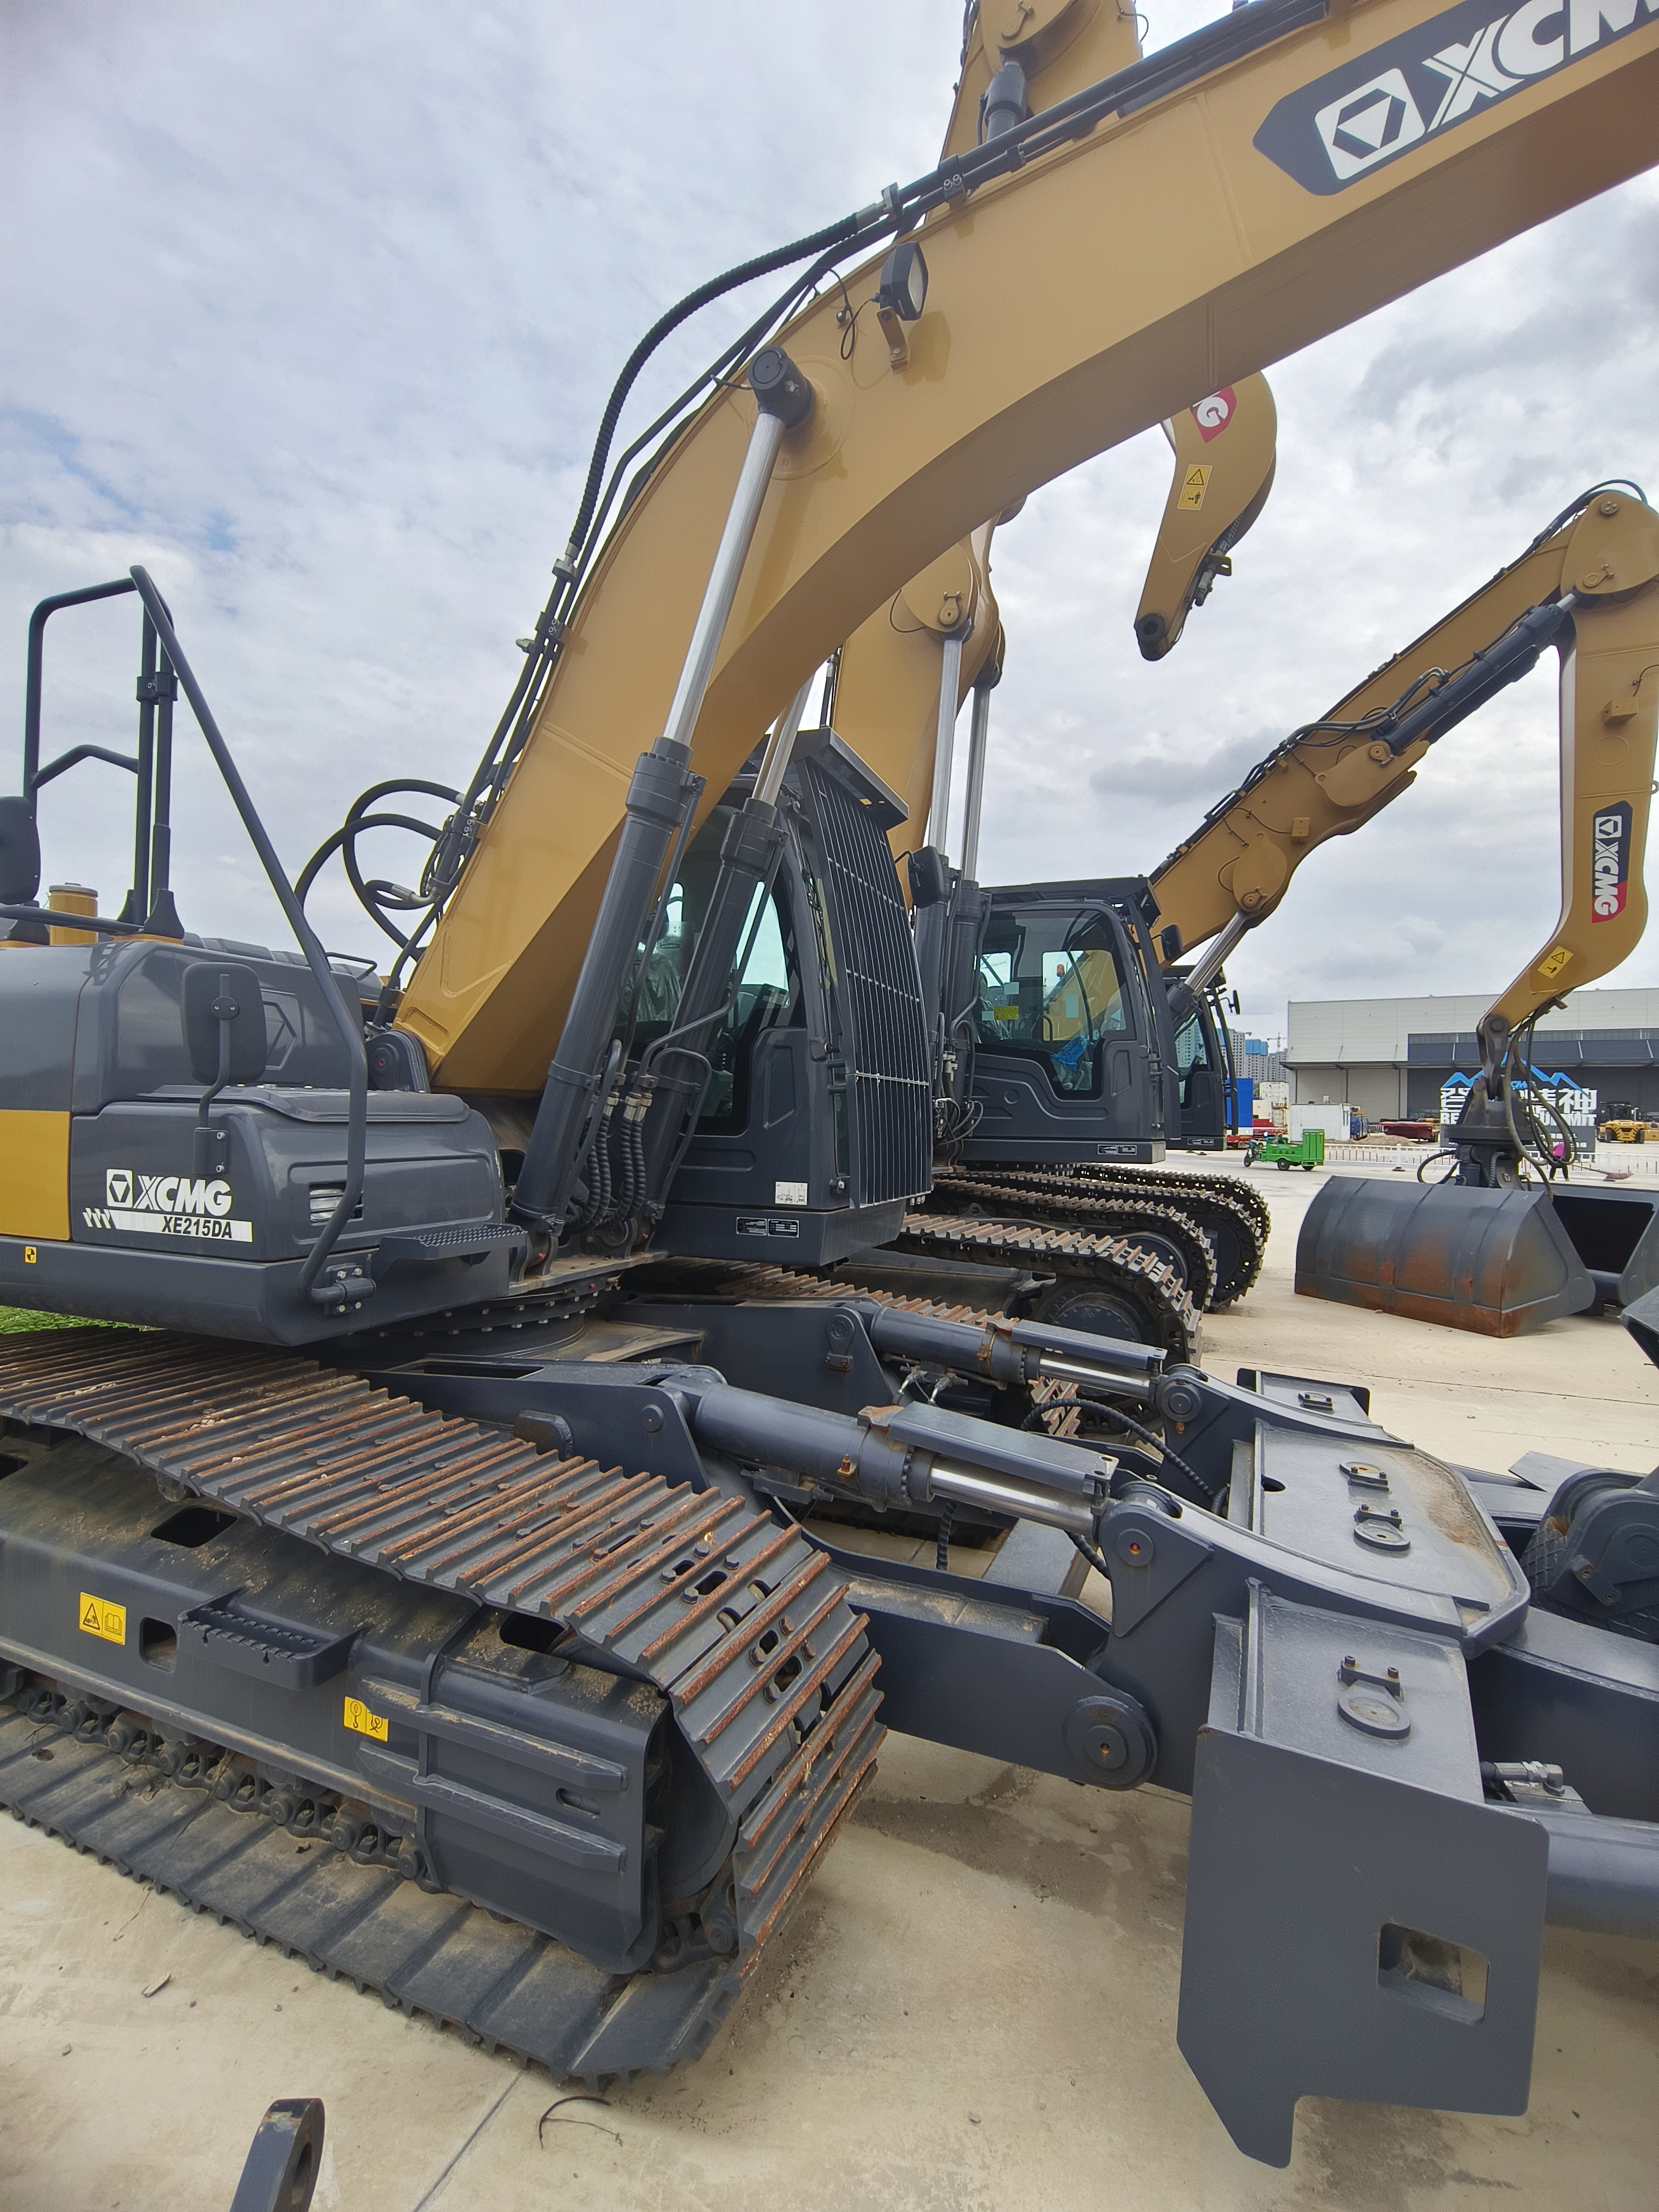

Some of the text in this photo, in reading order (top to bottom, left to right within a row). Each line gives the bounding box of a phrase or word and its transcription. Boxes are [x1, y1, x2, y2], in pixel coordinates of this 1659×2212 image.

[1422, 0, 1659, 133] XCM
[1594, 839, 1619, 916] XCMG
[133, 1175, 232, 1216] XCMG
[161, 1215, 233, 1239] XE215DA
